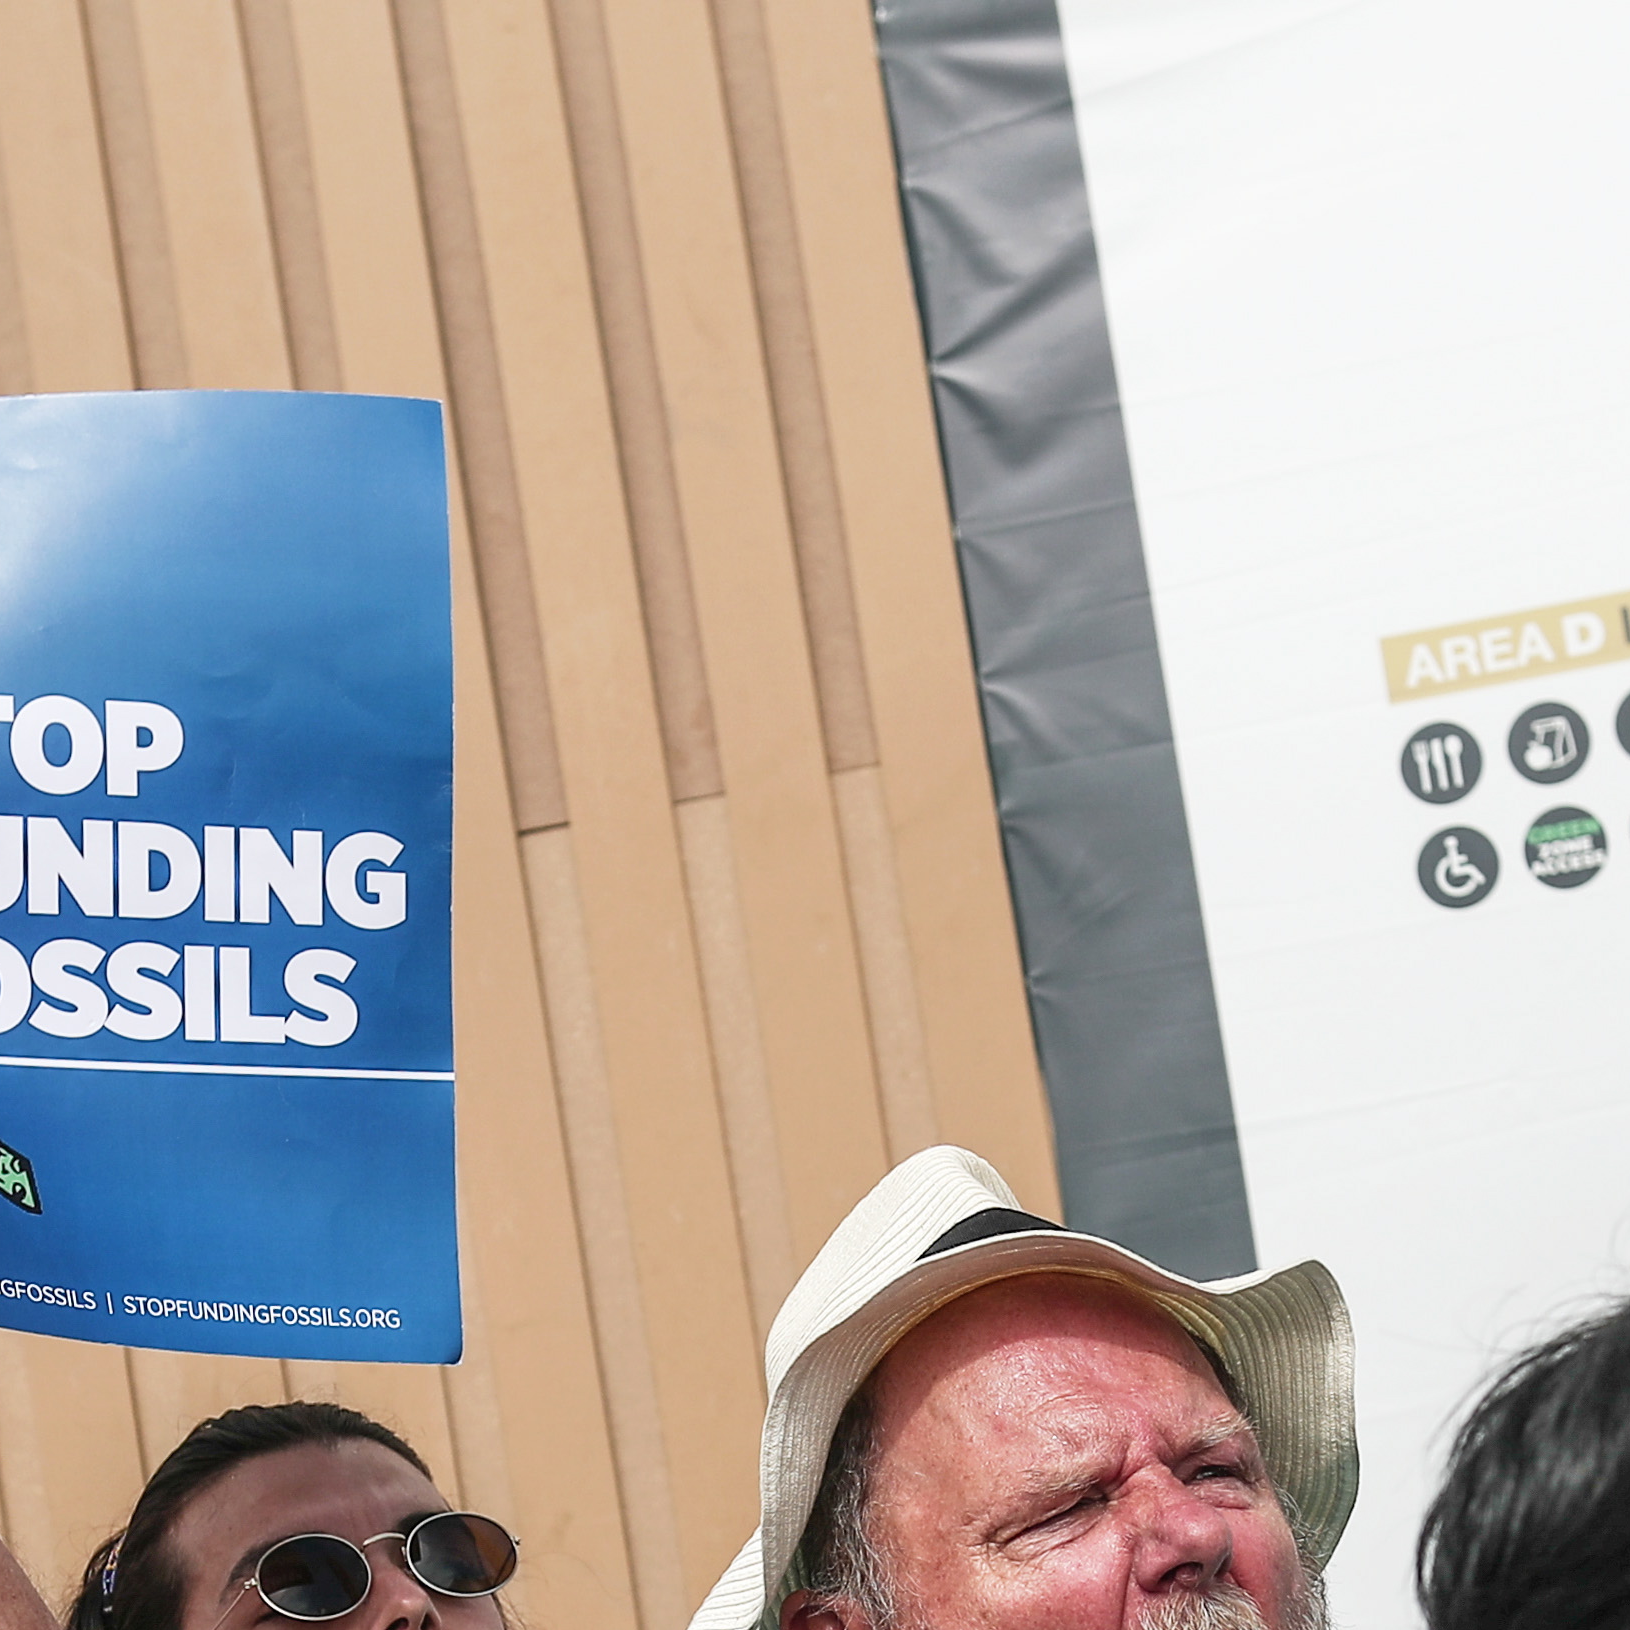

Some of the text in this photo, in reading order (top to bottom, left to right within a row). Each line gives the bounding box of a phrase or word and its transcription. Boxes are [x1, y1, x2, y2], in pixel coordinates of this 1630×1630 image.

[1405, 621, 1555, 690] AREA
[1562, 613, 1606, 657] D
[122, 1294, 401, 1331] STOPFUNDINGFOSSILS.ORG
